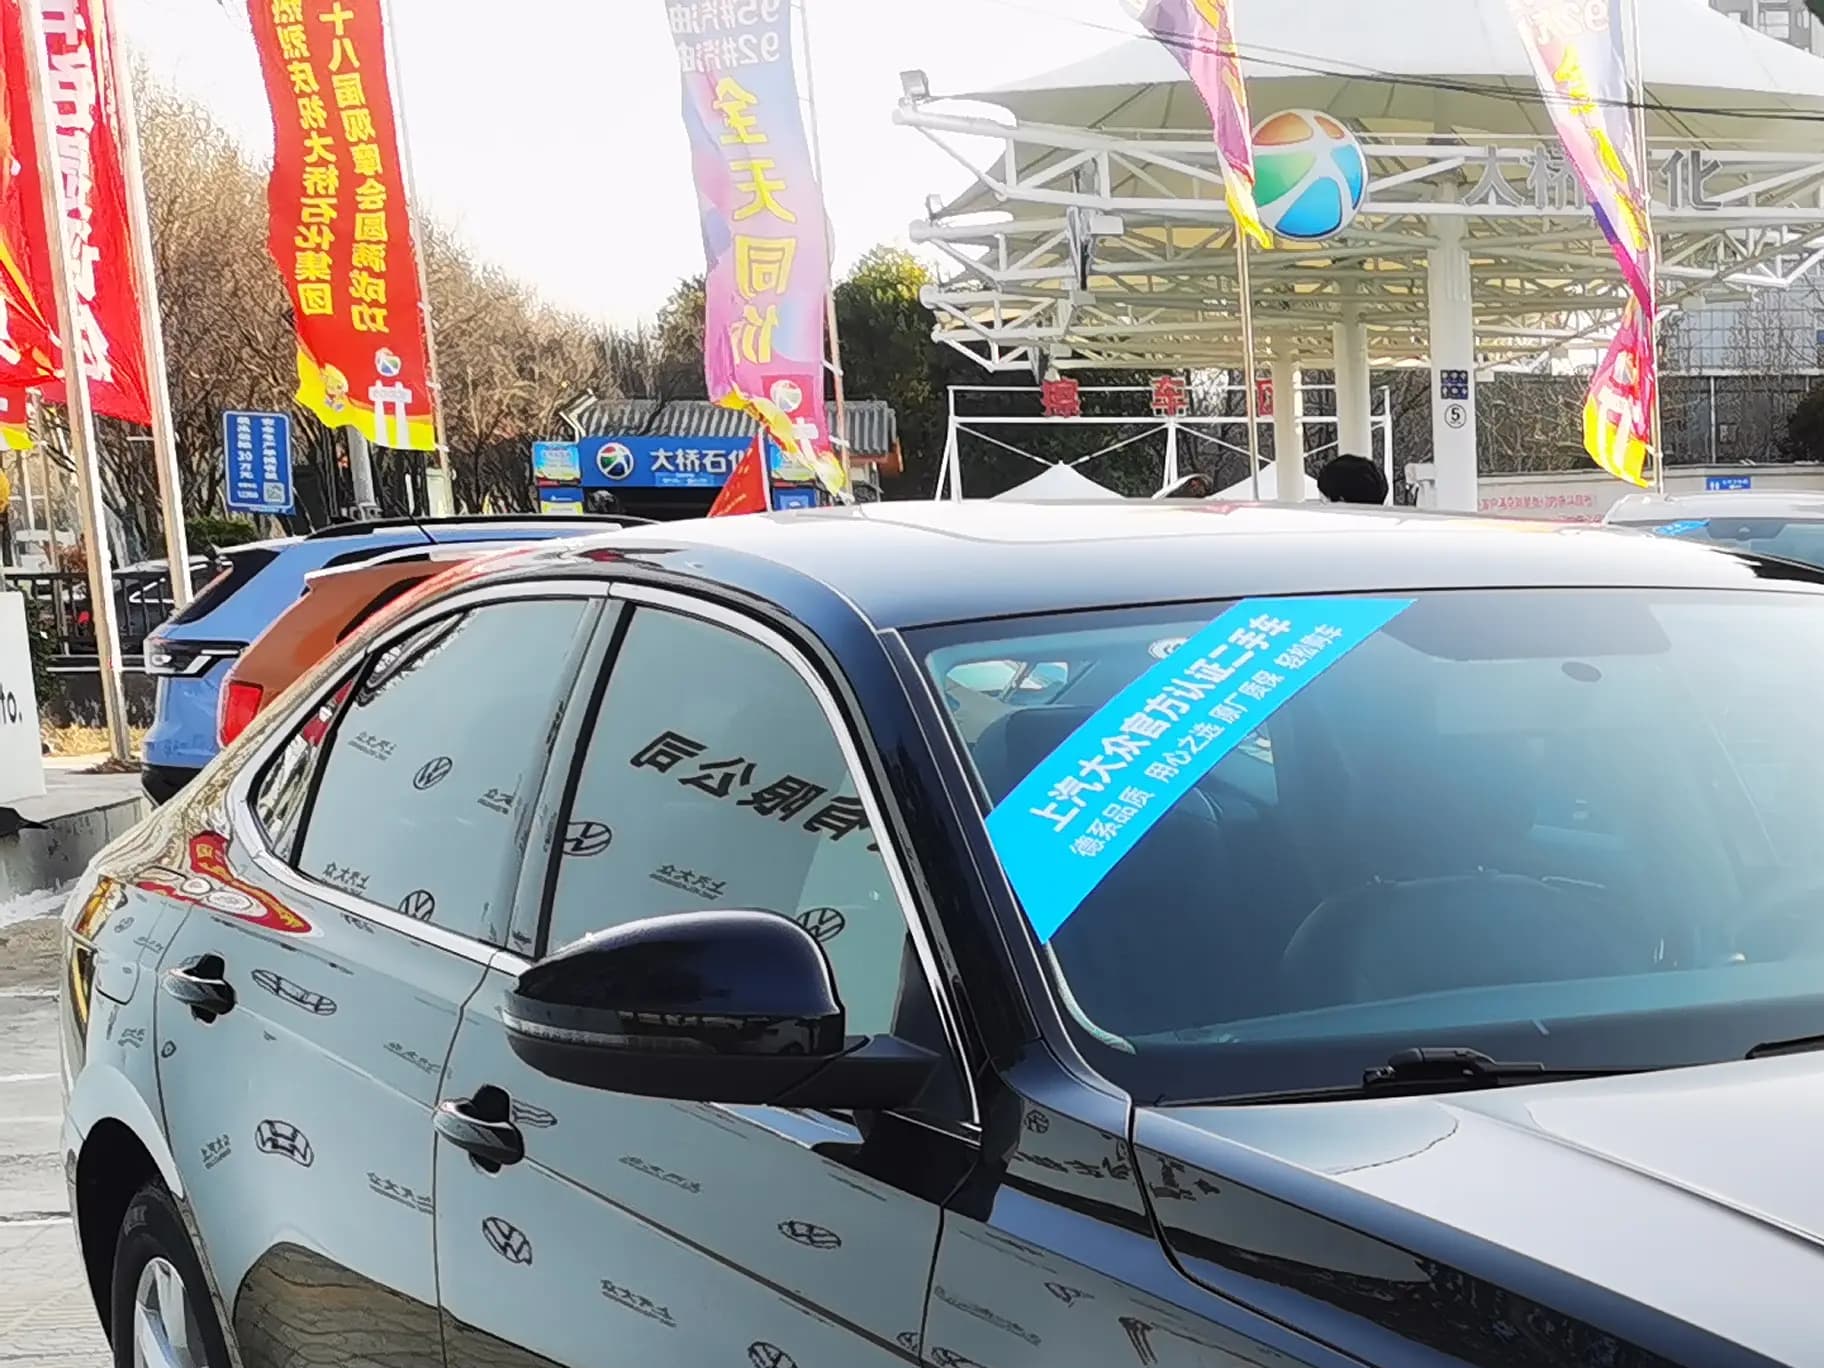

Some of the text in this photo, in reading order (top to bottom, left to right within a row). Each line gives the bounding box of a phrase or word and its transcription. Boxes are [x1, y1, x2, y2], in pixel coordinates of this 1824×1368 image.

[1462, 144, 1722, 211] 大桥化
[1028, 613, 1292, 833] 上汽大众官方认证二手车
